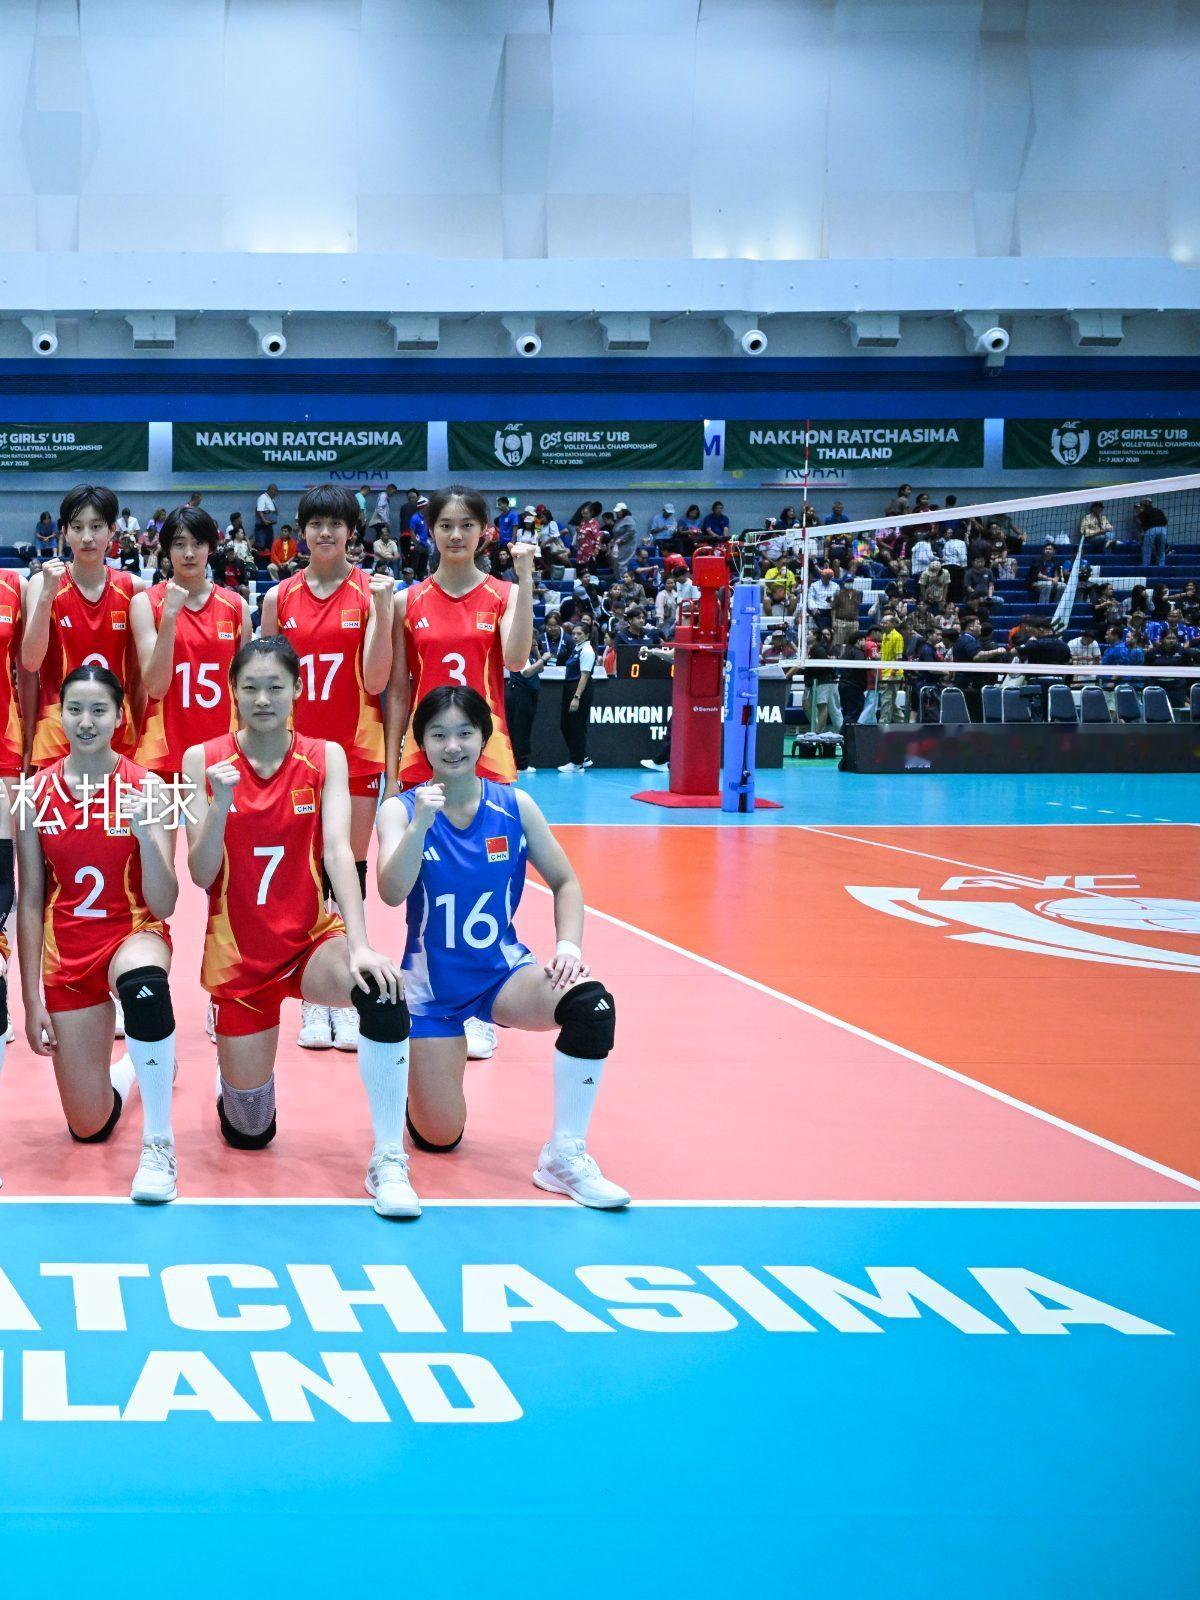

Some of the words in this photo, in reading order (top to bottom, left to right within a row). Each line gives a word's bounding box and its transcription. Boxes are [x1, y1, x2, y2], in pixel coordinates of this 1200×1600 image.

[52, 432, 76, 444] U18
[195, 431, 278, 446] NAKHON
[282, 431, 403, 446] RATCHASIMA
[540, 431, 562, 450] est
[607, 432, 630, 442] U18
[749, 430, 832, 445] NAKHON
[837, 428, 959, 444] RATCHASIMA
[1097, 429, 1119, 448] est
[1164, 429, 1188, 440] U18
[262, 450, 337, 462] THAILAND
[506, 451, 520, 463] 18
[817, 447, 893, 459] THAILAND
[1062, 449, 1077, 462] 18
[300, 653, 344, 700] 17
[441, 653, 468, 686] 3
[631, 664, 639, 677] 0
[176, 662, 222, 708] 15
[590, 706, 663, 724] NAKHON
[253, 846, 284, 906] 7
[73, 866, 107, 918] 2
[435, 891, 498, 950] 16
